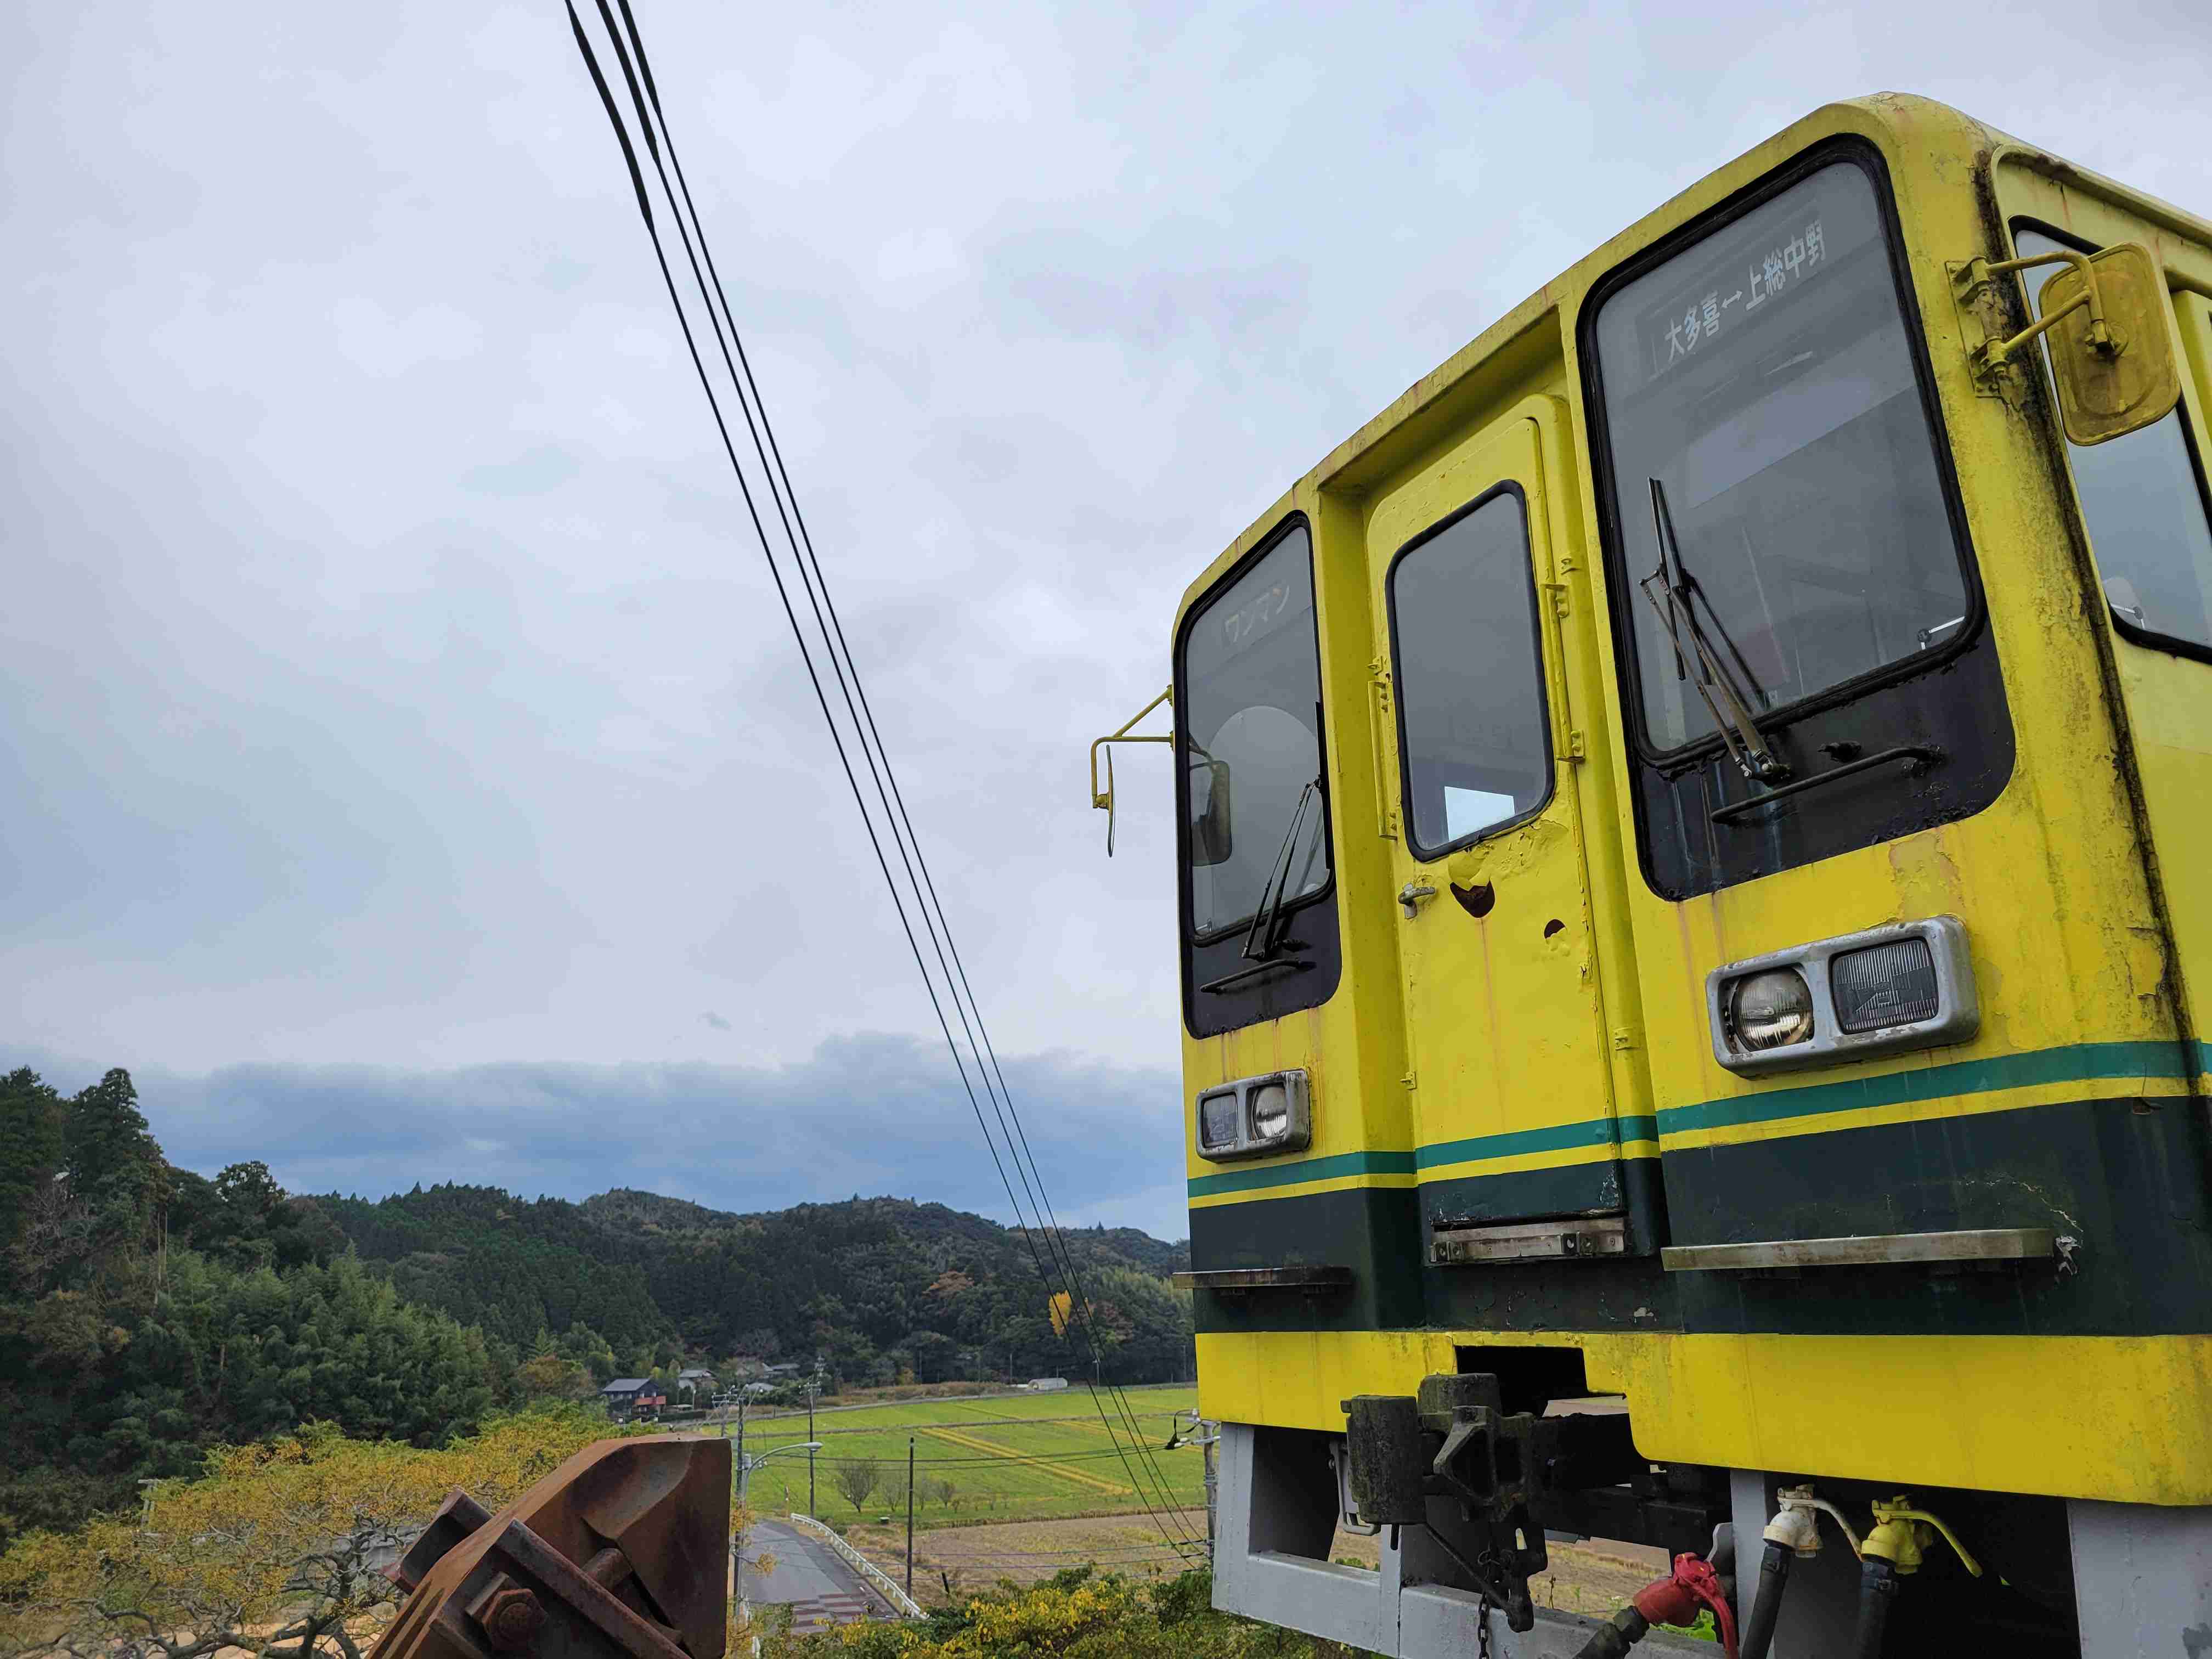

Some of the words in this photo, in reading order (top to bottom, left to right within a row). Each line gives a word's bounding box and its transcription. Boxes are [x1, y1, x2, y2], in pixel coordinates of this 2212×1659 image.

[1664, 290, 1721, 364] 大多喜
[1224, 584, 1290, 643] ワンマン
